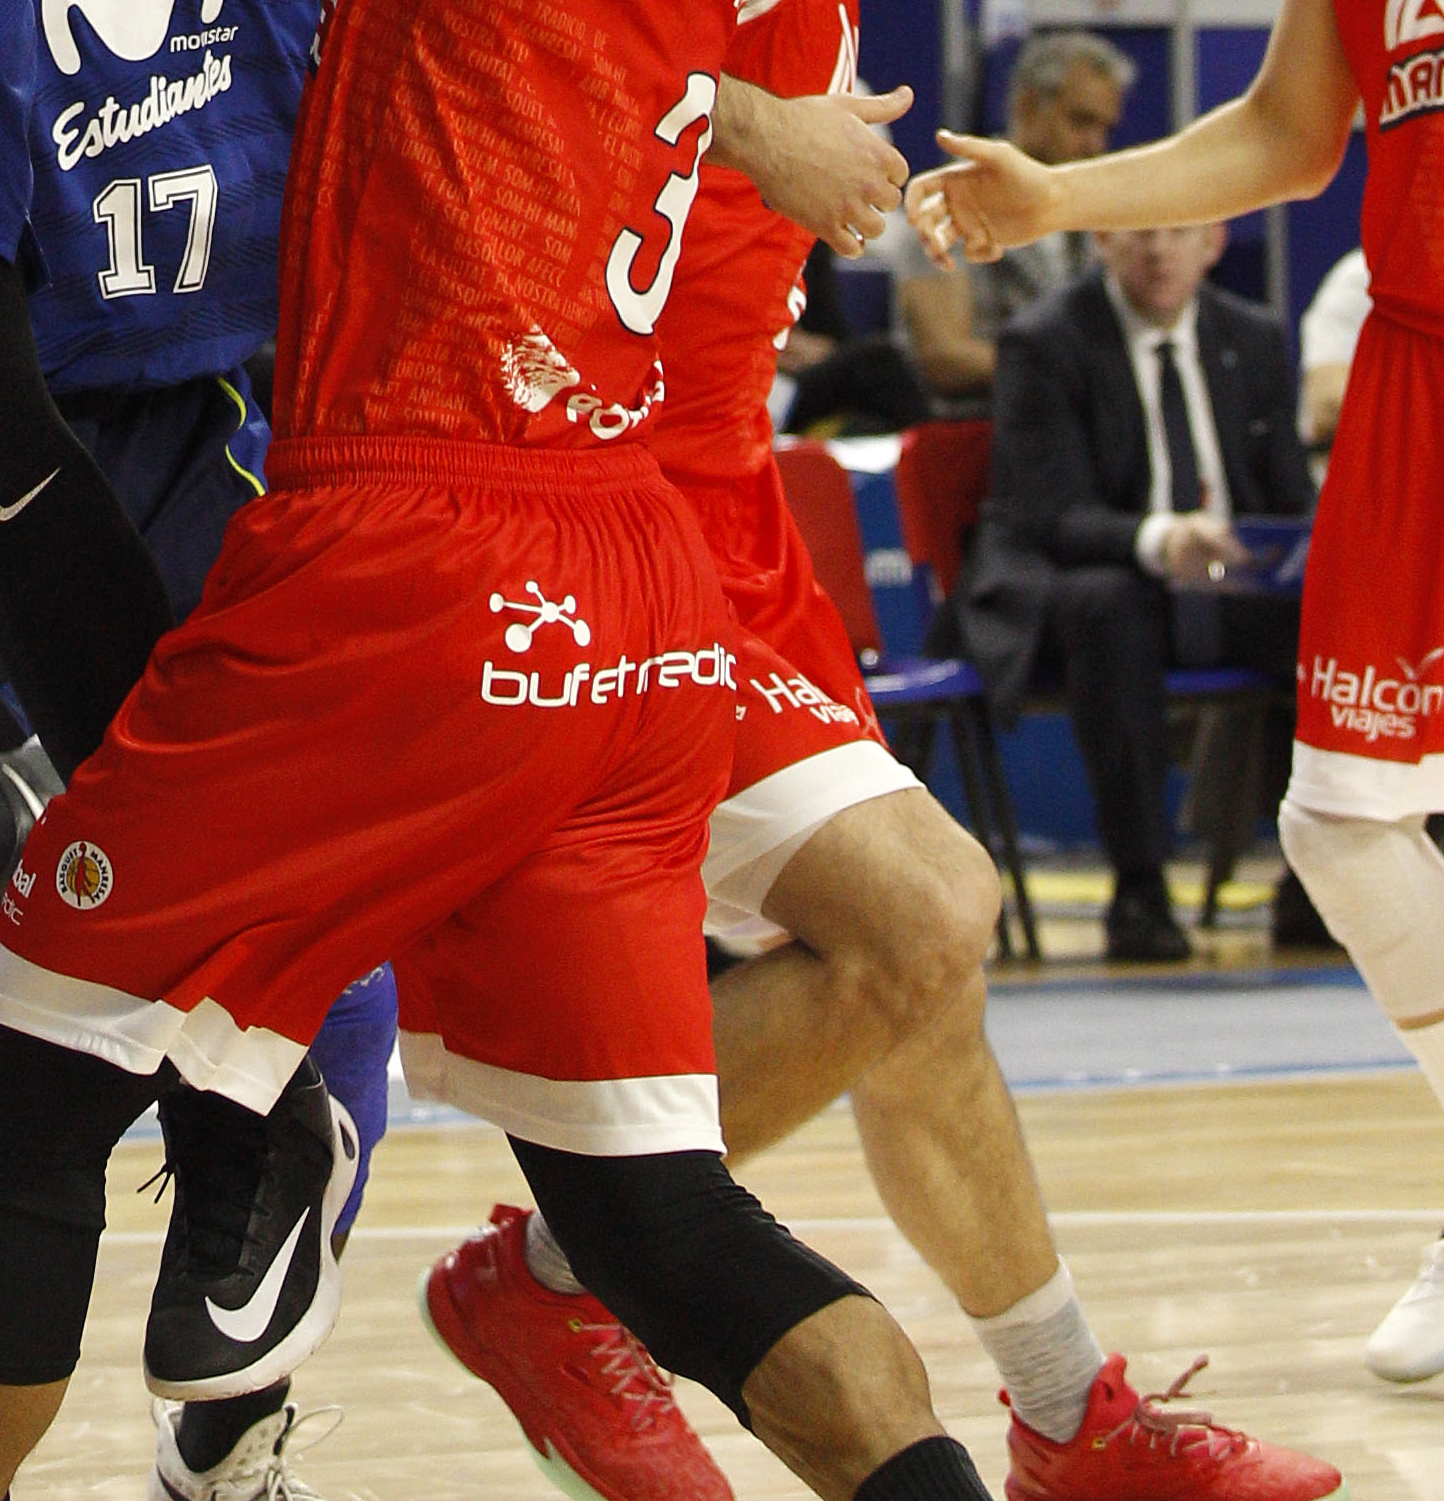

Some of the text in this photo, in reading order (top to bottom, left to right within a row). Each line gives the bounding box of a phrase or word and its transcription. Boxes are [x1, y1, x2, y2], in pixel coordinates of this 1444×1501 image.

[52, 49, 233, 172] Estudiantes
[92, 164, 220, 300] 17
[605, 73, 719, 336] 3
[1330, 704, 1417, 744] viajes
